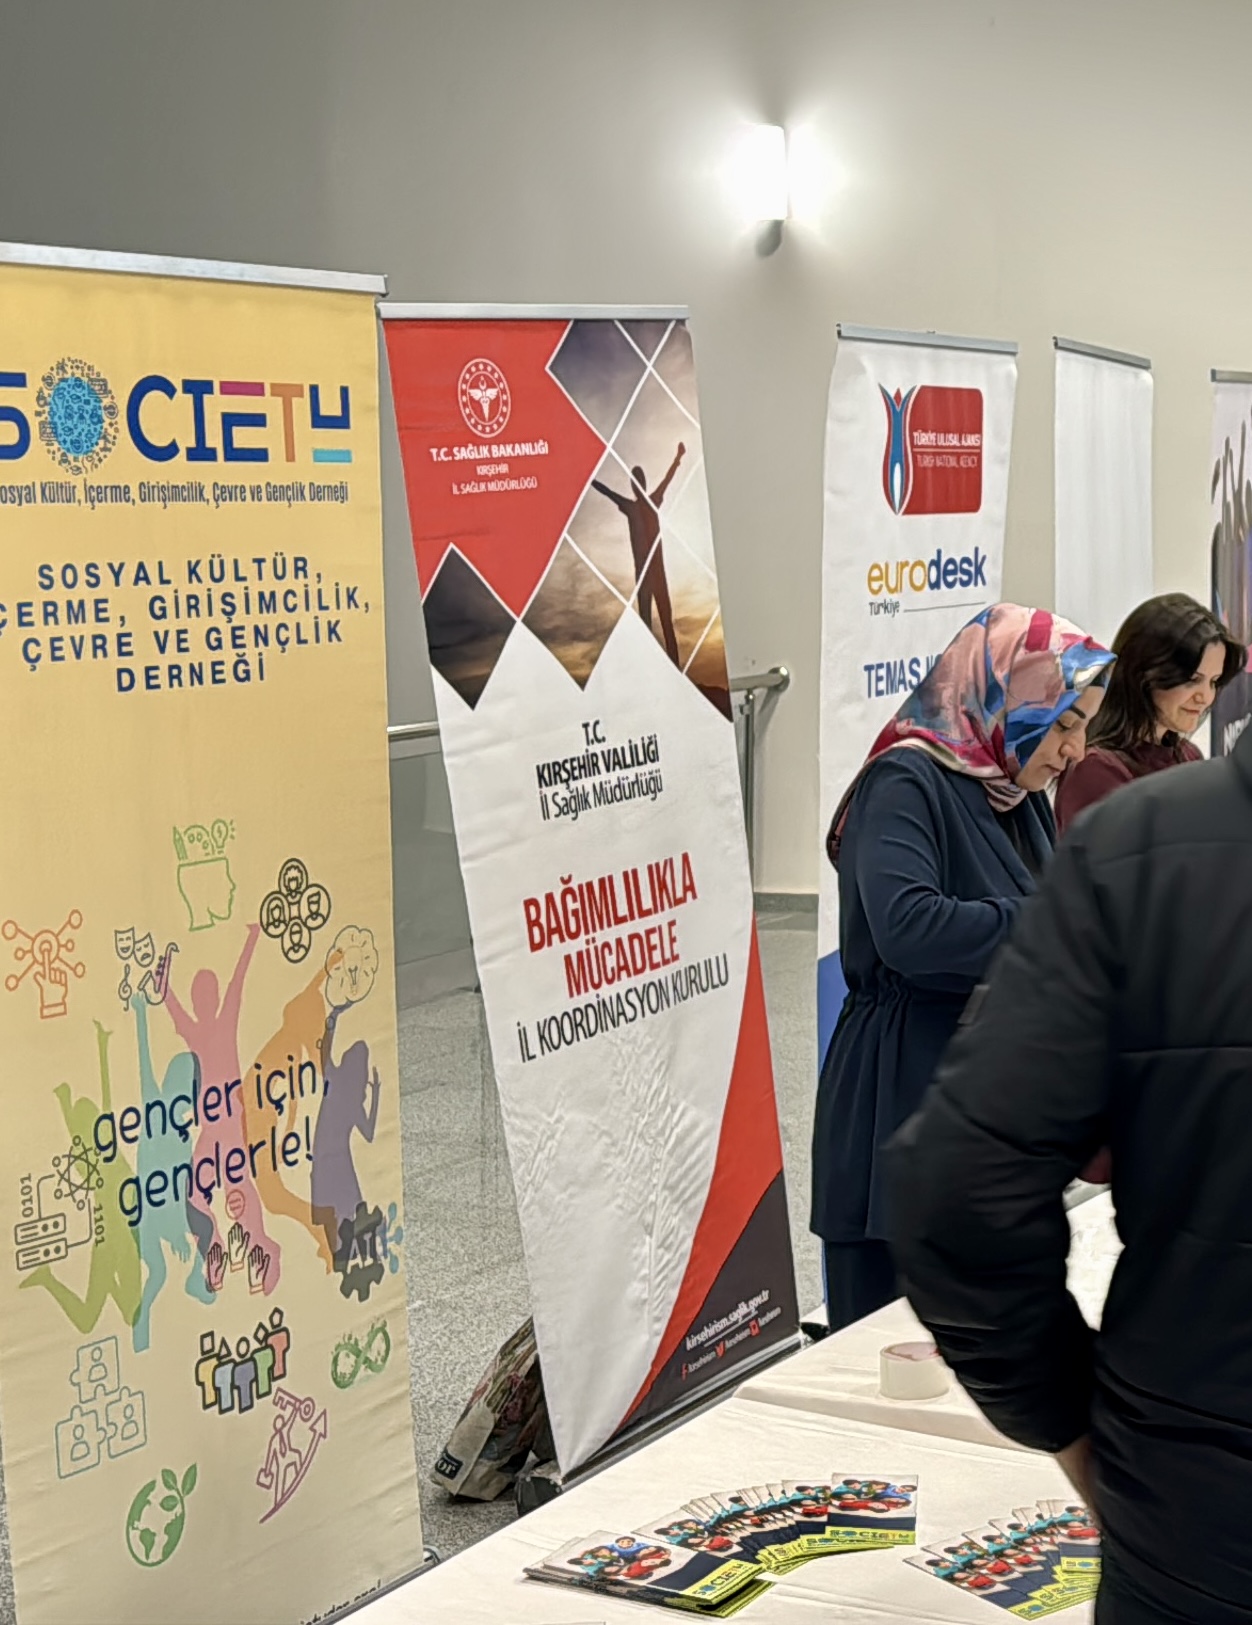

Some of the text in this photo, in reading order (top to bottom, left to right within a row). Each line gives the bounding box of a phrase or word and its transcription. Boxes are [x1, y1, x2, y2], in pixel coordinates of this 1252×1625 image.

[429, 439, 549, 461] T.C. SAĞLIK BAKANLIĞI
[476, 462, 509, 477] KIRŞEHİR
[0, 478, 348, 510] osyal Kültür, İçerme, Girişimcilik, Çevre ve Gençlik Derneği
[461, 480, 486, 495] SAĞLIK
[487, 476, 538, 492] MÜDÜRLÜĞÜ
[37, 551, 322, 591] SOSYAL KÜLTÜR,
[867, 546, 987, 596] eurodesk
[0, 582, 371, 637] ERME, GİRİŞİMCİLİK,
[868, 599, 900, 618] Türkiye
[22, 616, 342, 671] ÇEVRE VE GENÇLİK
[116, 652, 265, 692] DERNEĞİ
[863, 656, 921, 699] TEMAS
[582, 719, 606, 746] T.C.
[536, 733, 660, 790] KIRŞEHİR VALİLİĞİ
[539, 768, 664, 821] İl Sağlık Müdürlüğü
[523, 852, 698, 953] BAĞIMLILIKLA
[563, 919, 680, 999] MÜCADELE
[517, 953, 729, 1063] İL KOORDİNASYON KURULU
[93, 1054, 329, 1163] gençler için,
[119, 1116, 313, 1227] gençlerle!
[346, 1232, 374, 1274] AI
